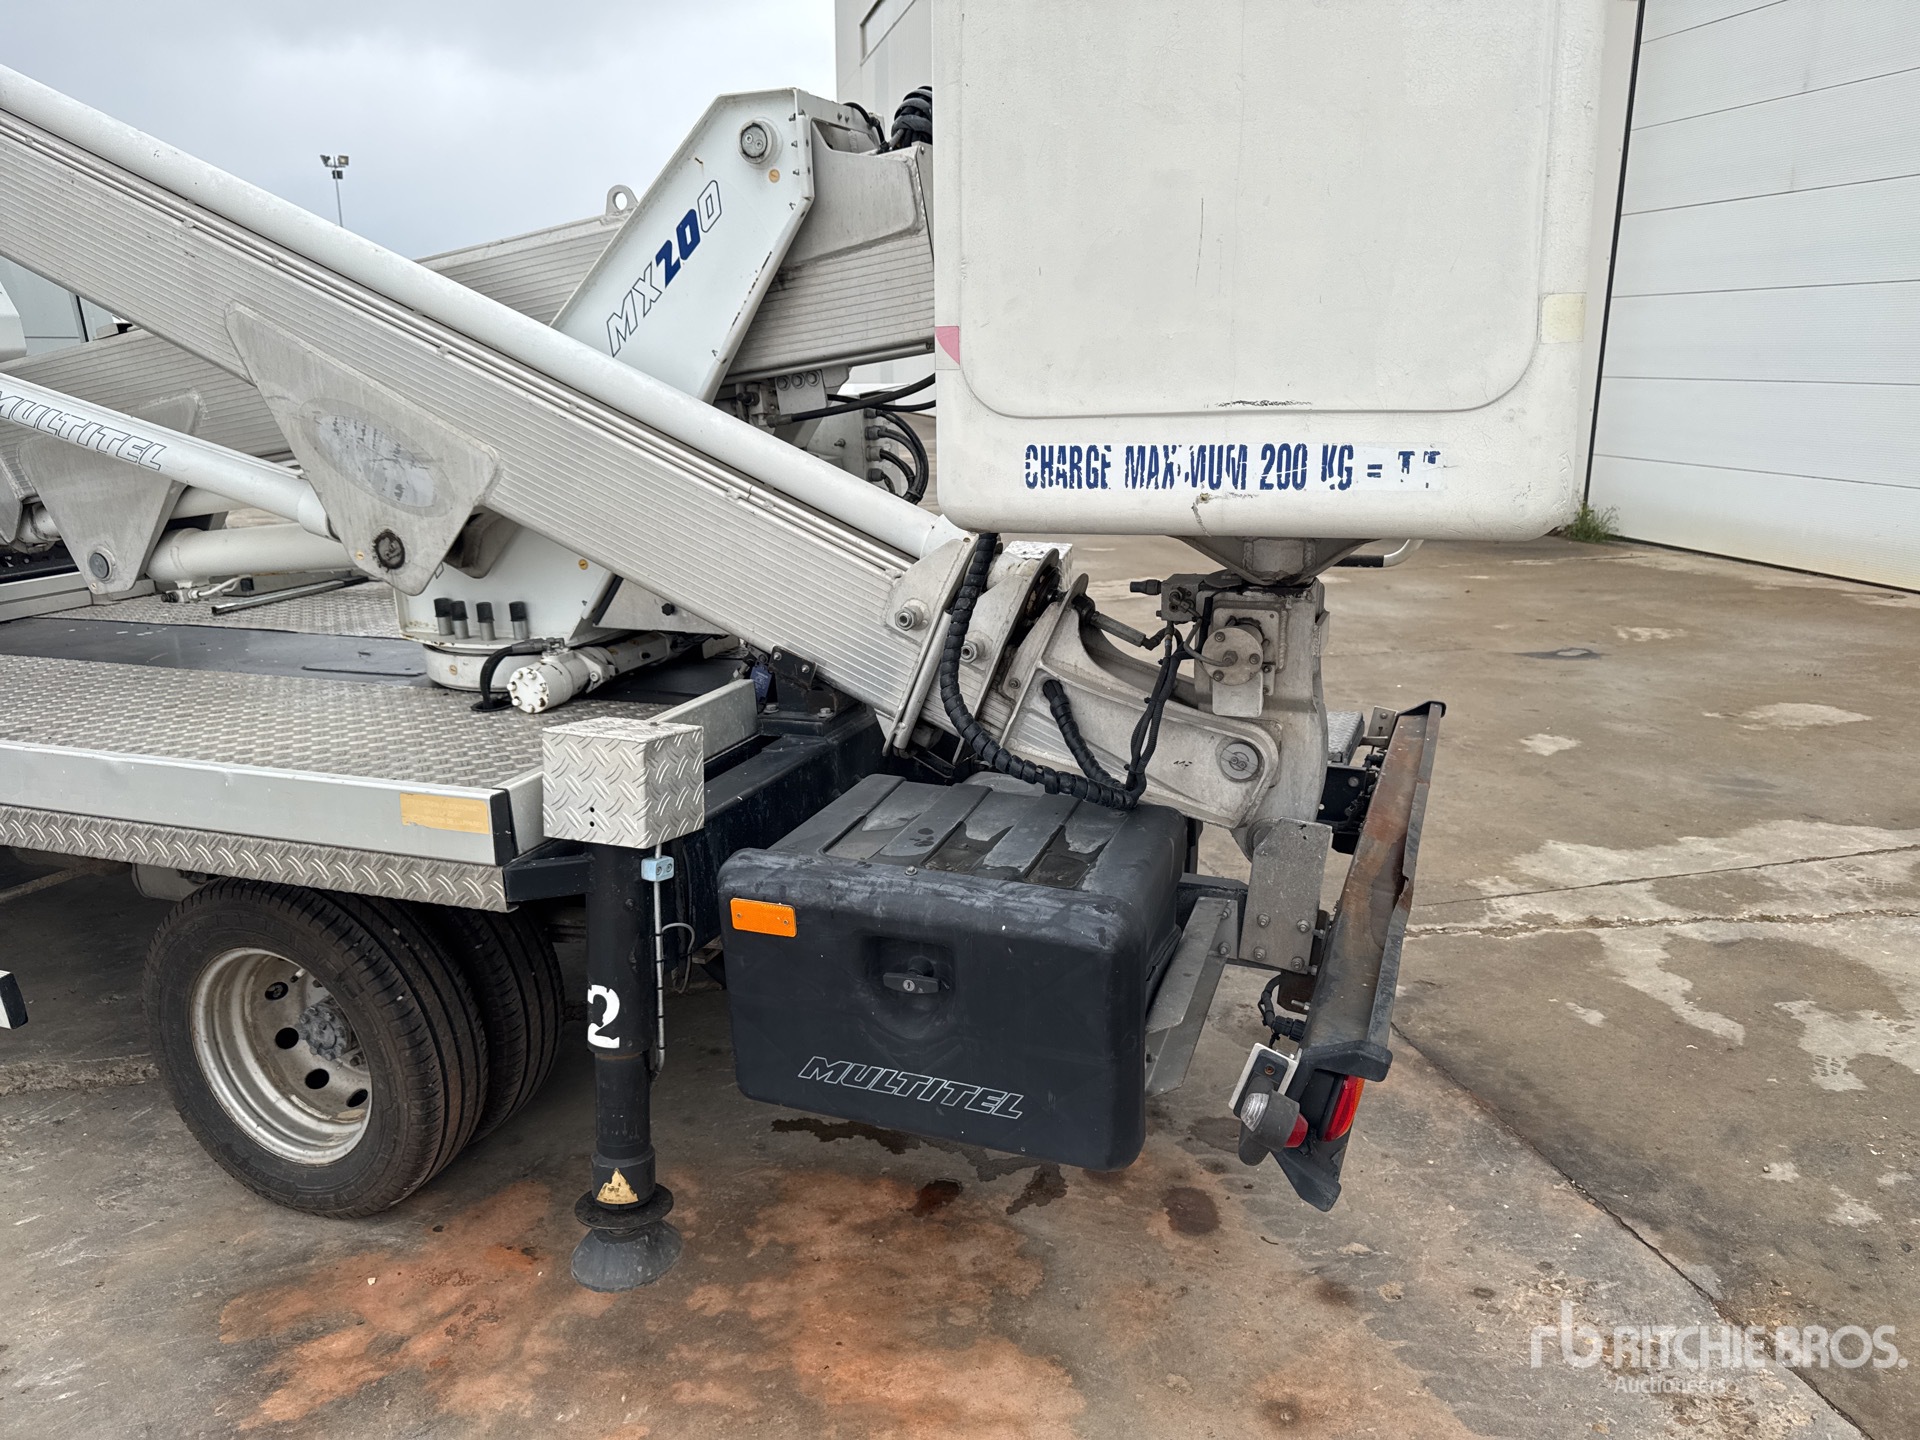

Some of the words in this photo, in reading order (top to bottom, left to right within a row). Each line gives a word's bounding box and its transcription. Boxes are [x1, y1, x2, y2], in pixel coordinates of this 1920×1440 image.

[606, 179, 723, 358] MX200
[1025, 444, 1112, 490] CHARGE
[1125, 444, 1248, 490] MAXMUM
[1259, 443, 1308, 491] 200
[1320, 444, 1354, 491] KG
[587, 984, 620, 1049] 2
[797, 1055, 1024, 1120] MULTITEL
